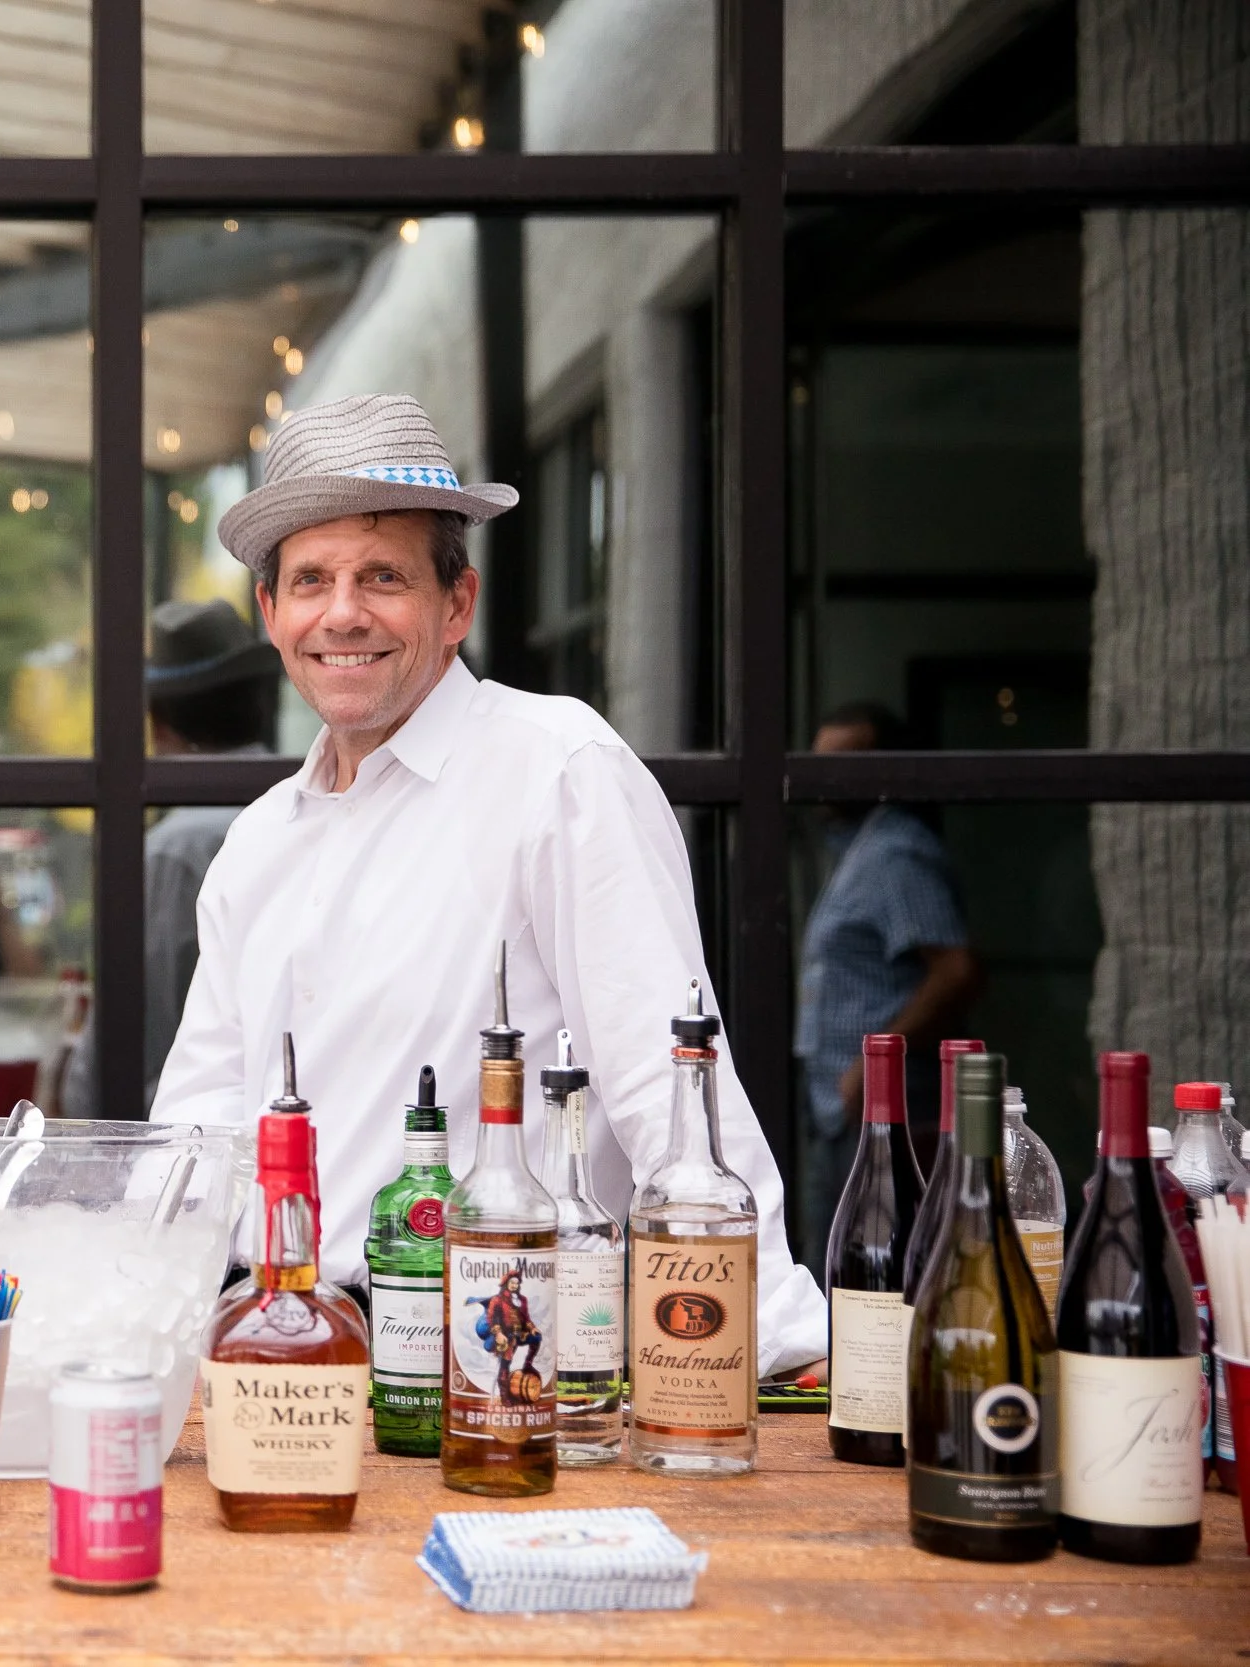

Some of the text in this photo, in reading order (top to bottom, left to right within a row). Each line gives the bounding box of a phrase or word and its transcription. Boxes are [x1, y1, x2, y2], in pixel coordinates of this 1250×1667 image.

[460, 1256, 556, 1283] Captain Morgan
[646, 1250, 734, 1283] Tito's
[576, 1328, 618, 1337] CASAMIGOS
[398, 1344, 443, 1352] IMPORTED
[639, 1344, 744, 1371] Handmade
[234, 1379, 354, 1400] Maker's
[660, 1375, 718, 1389] VODKA
[385, 1394, 443, 1406] LONDON DRY
[268, 1407, 351, 1426] Mark
[466, 1411, 522, 1427] SPICED
[526, 1411, 551, 1427] RUM
[646, 1407, 679, 1417] AUSTIN
[252, 1438, 336, 1450] WHISKY
[957, 1484, 1021, 1499] Sauvignon
